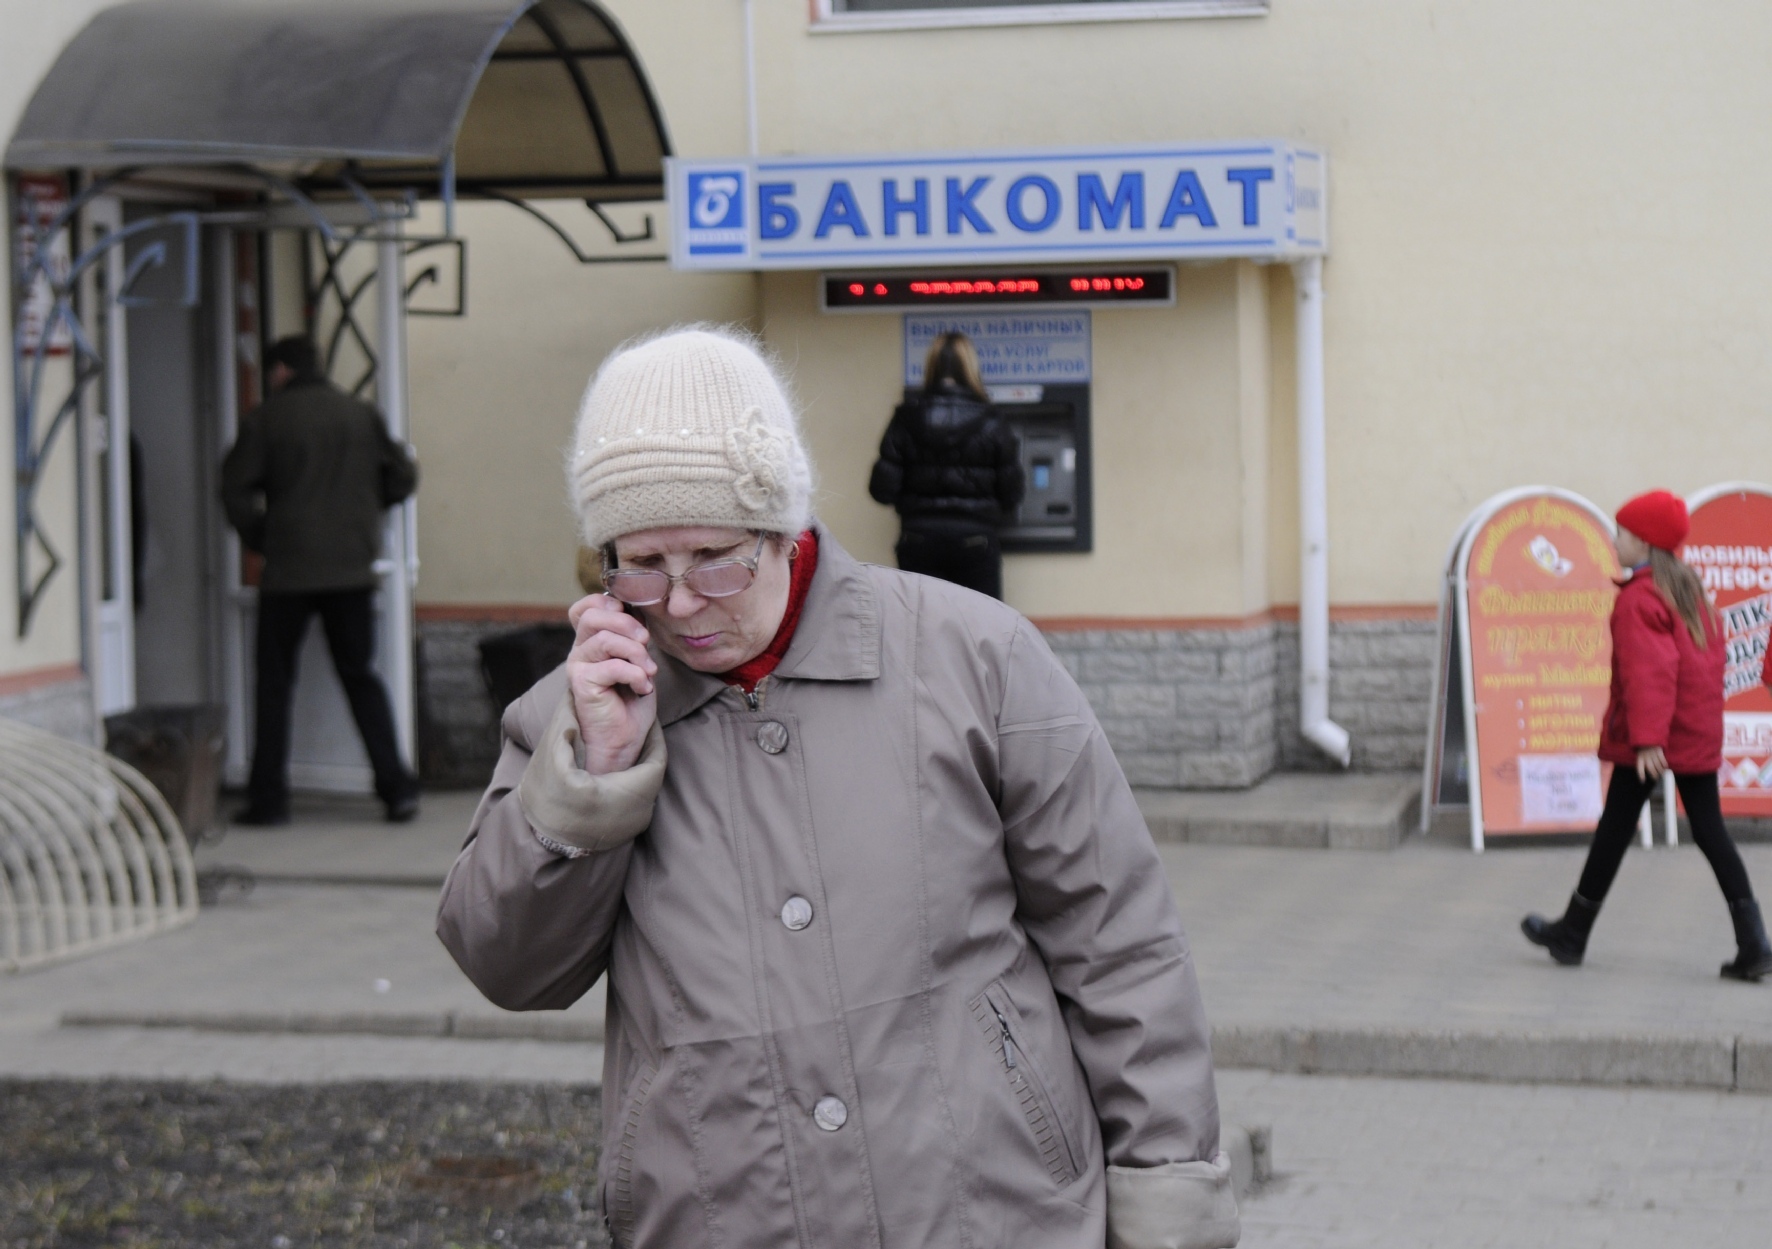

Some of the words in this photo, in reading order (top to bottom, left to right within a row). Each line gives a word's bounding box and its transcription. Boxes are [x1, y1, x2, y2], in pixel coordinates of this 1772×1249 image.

[758, 168, 1274, 240] БАНКОМАТ
[912, 320, 983, 336] ВЫДАЧА
[987, 318, 1085, 335] НАЛИЧНЫХ
[1005, 344, 1050, 359] УСЛУГ
[1026, 357, 1086, 374] КАРТОЙ
[1683, 545, 1772, 567] МОБИЛЬ
